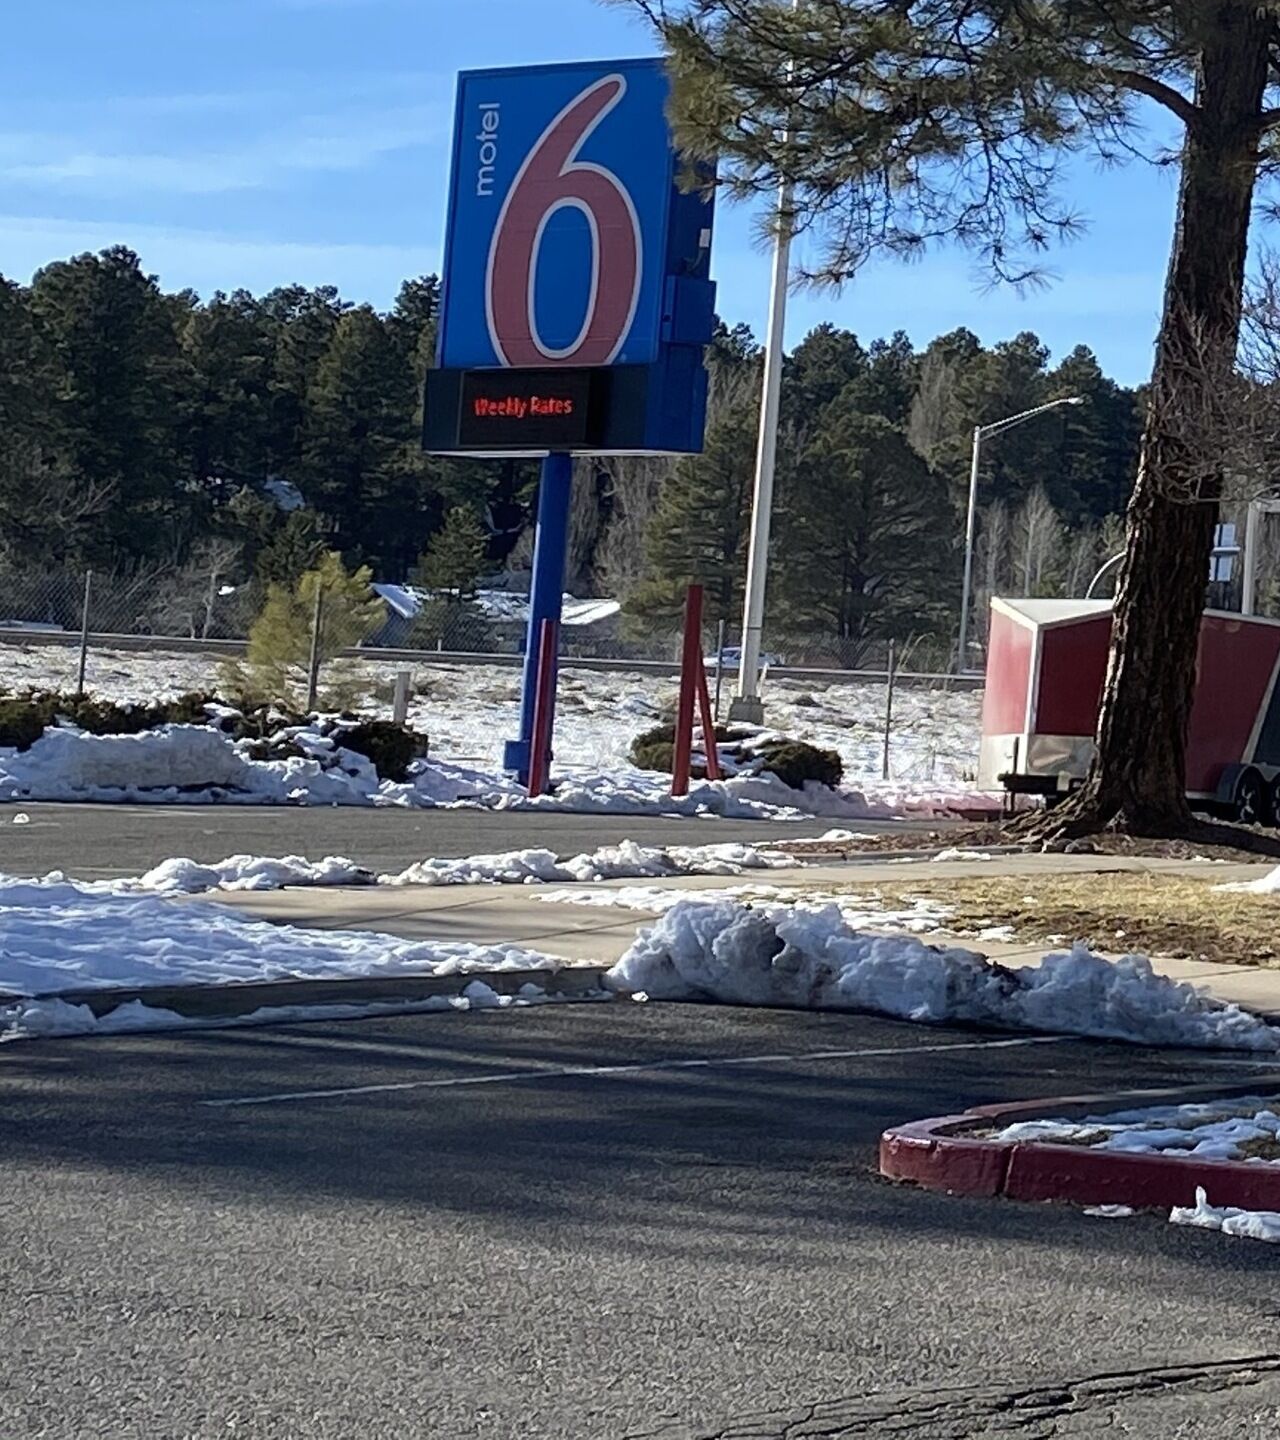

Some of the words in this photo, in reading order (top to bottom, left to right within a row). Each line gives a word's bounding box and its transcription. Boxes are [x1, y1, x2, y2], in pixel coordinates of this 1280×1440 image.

[476, 103, 501, 197] motel
[485, 73, 643, 368] 6
[474, 396, 528, 419] Weekly
[530, 395, 573, 415] Rates
